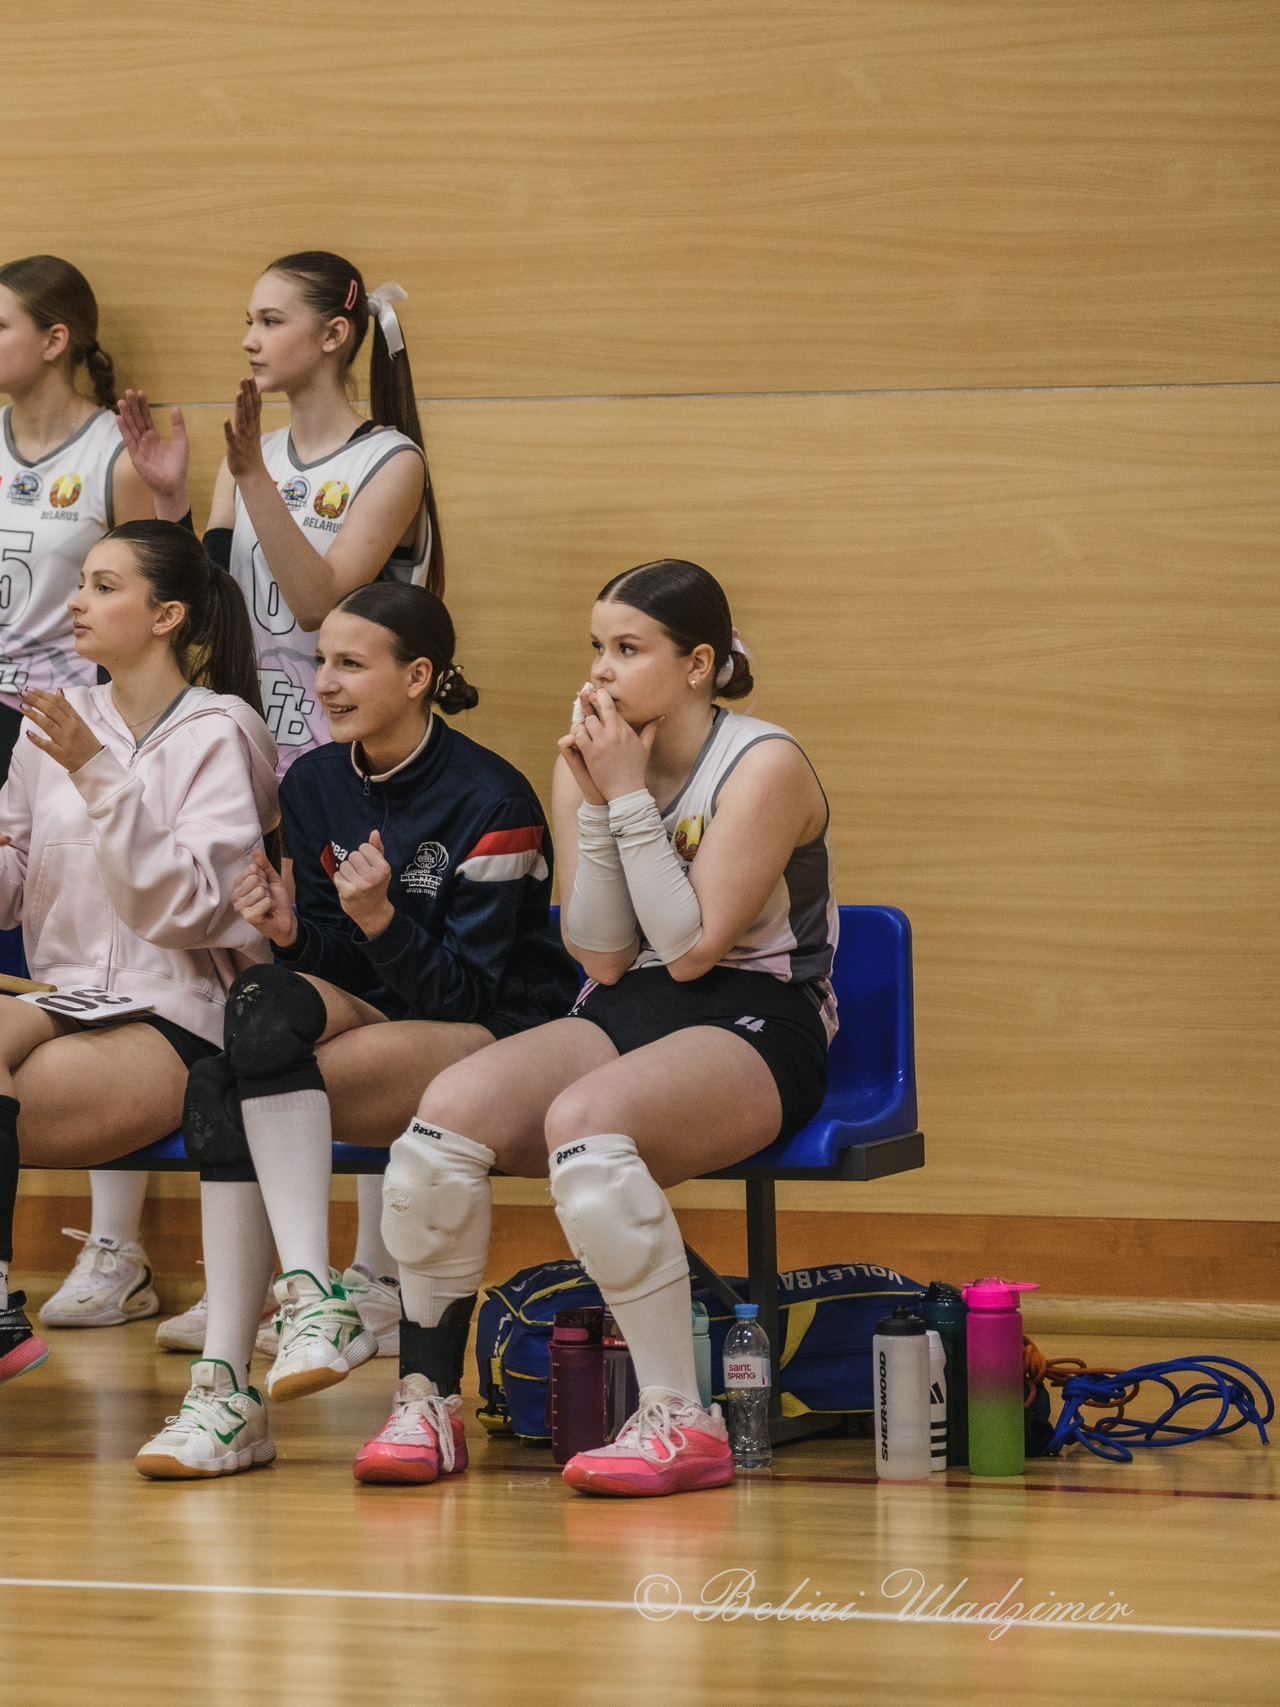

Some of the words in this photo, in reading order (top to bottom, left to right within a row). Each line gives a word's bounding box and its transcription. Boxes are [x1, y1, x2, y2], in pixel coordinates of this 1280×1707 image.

[418, 1126, 443, 1140] asics
[562, 1144, 586, 1159] asics
[778, 1263, 904, 1291] VOLLEYBA
